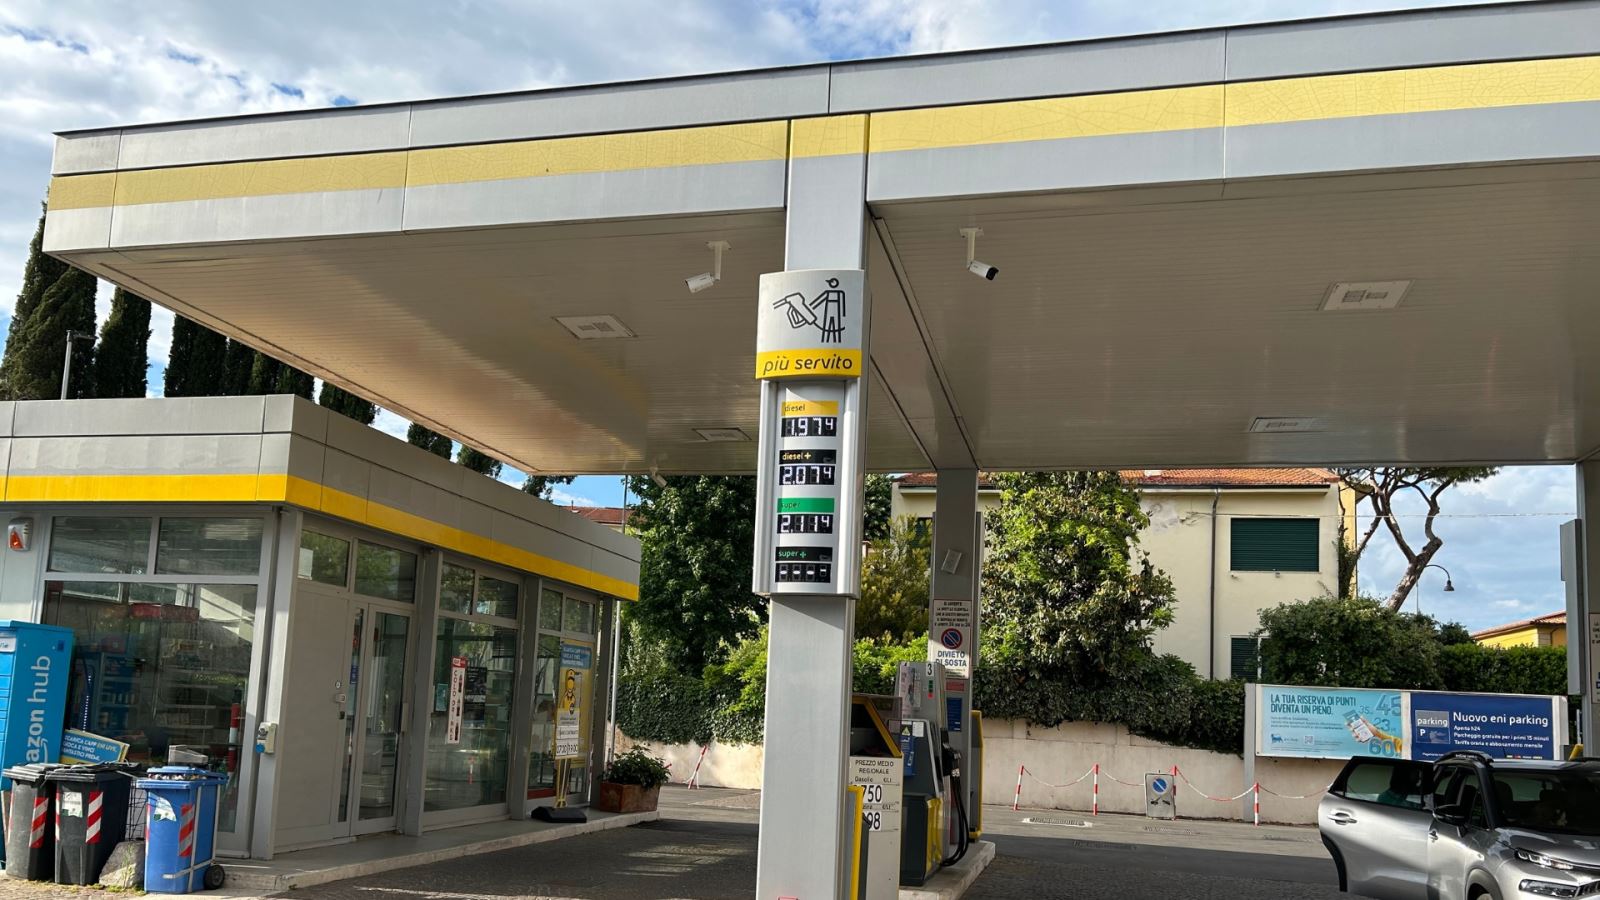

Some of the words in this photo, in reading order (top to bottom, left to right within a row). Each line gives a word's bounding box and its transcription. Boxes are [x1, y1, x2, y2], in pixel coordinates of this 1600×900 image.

[763, 356, 789, 376] più
[794, 354, 852, 370] servito
[928, 664, 932, 675] 3
[27, 656, 50, 702] hub
[1271, 694, 1280, 703] LA
[1282, 695, 1296, 704] TUA
[1298, 695, 1327, 704] RISERVA
[1328, 696, 1335, 705] DI
[1336, 697, 1356, 706] PUNTI
[1271, 704, 1300, 713] DIVENTA
[1301, 705, 1311, 713] UN
[1376, 694, 1401, 716] 45
[1373, 717, 1390, 731] 23
[1417, 718, 1448, 728] parking
[1453, 712, 1487, 722] Nuovo
[1490, 714, 1506, 723] eni
[1510, 715, 1548, 727] parking
[26, 709, 45, 762] azon
[1369, 739, 1395, 757] 60
[860, 785, 882, 802] 750
[867, 812, 880, 830] 98
